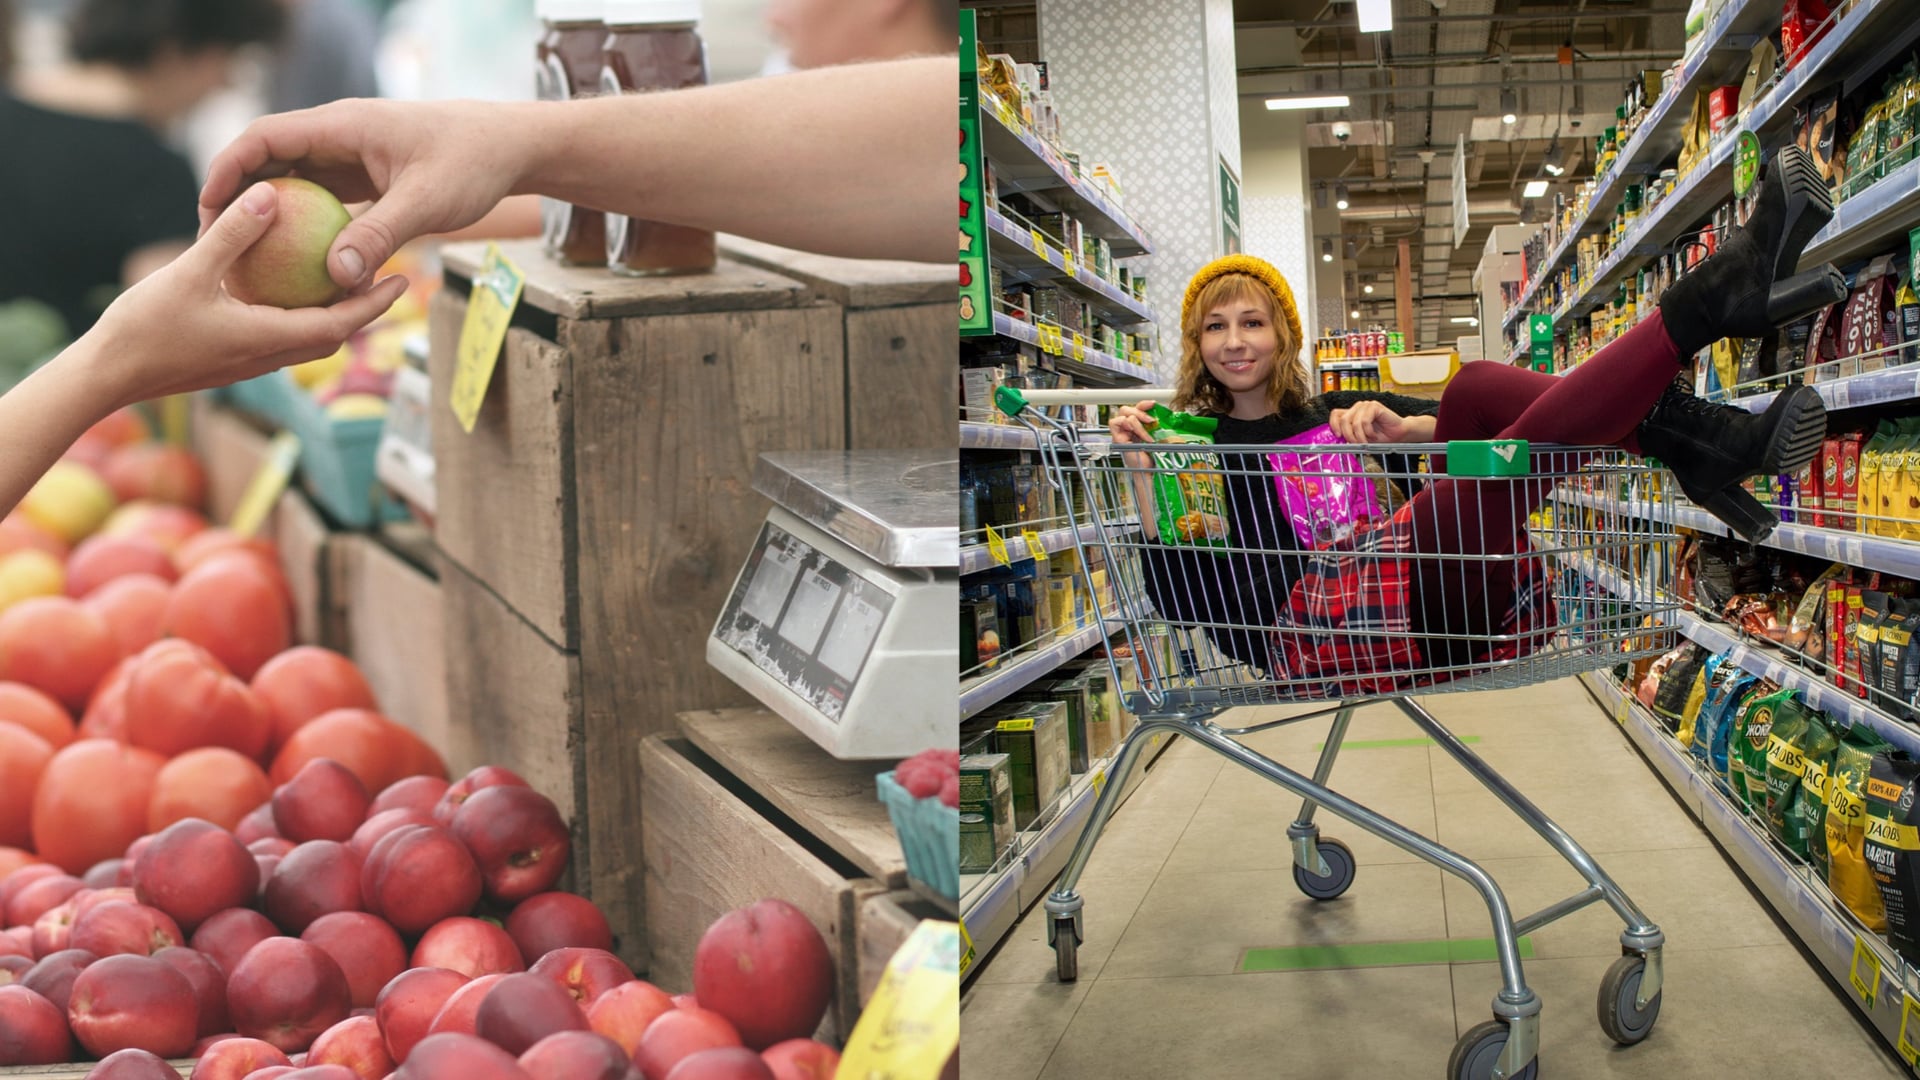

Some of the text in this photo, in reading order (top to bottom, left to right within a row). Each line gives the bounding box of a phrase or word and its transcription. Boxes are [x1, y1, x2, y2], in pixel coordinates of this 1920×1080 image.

[1849, 292, 1865, 353] COSTA
[1864, 283, 1876, 351] COSTA
[1865, 843, 1896, 867] BARISTA
